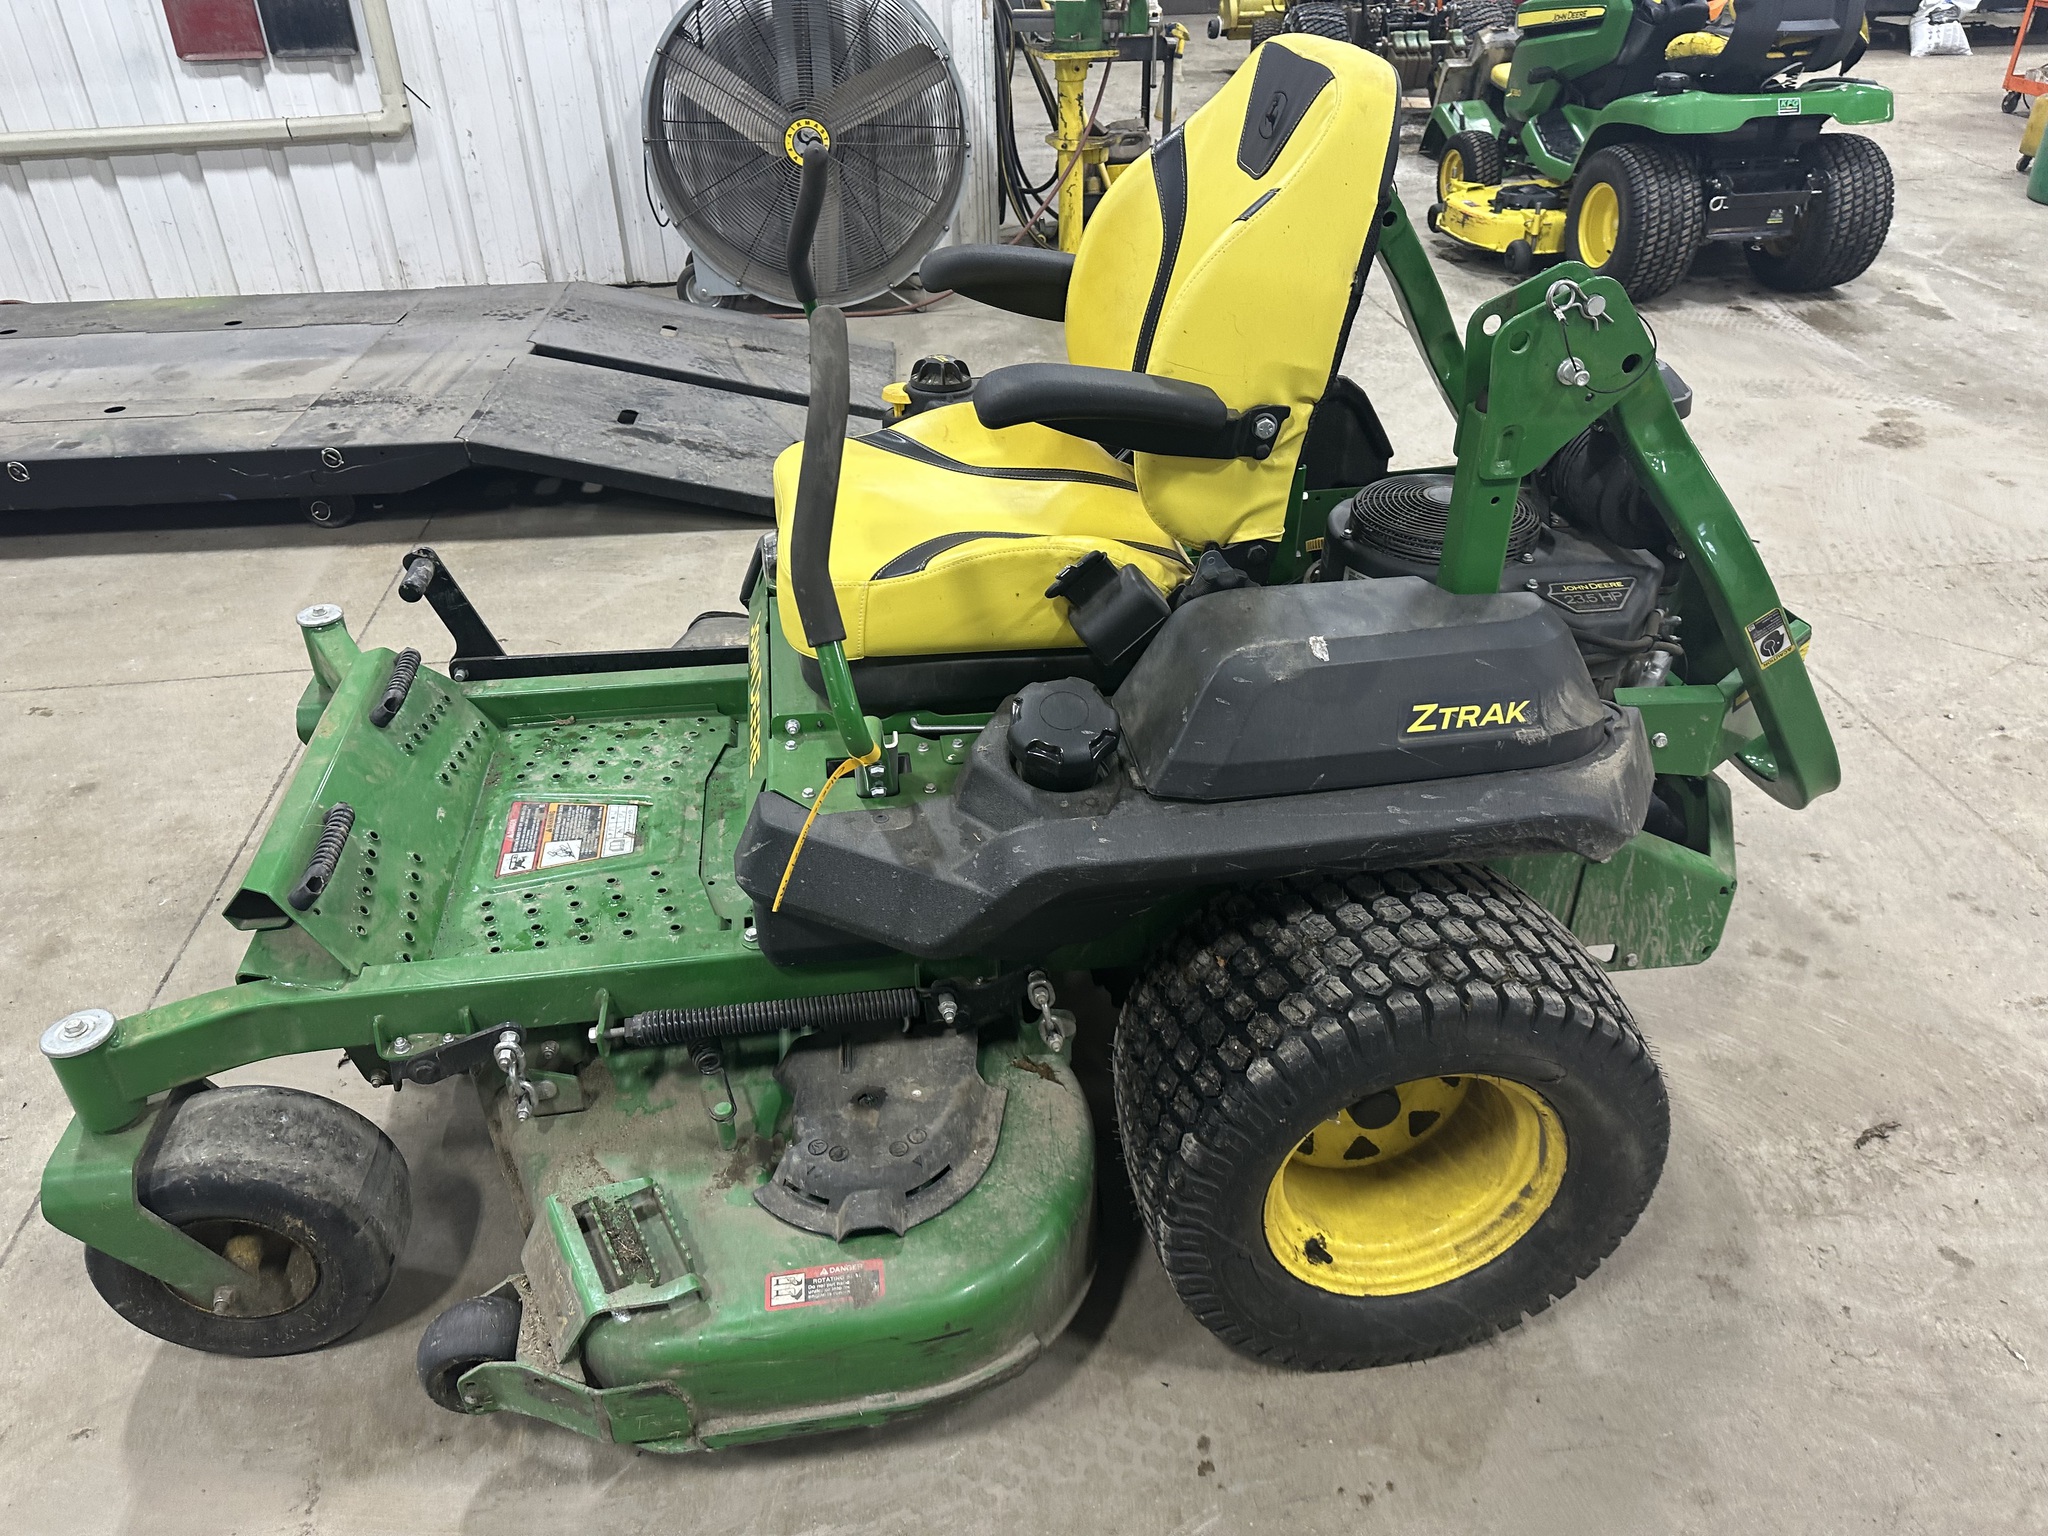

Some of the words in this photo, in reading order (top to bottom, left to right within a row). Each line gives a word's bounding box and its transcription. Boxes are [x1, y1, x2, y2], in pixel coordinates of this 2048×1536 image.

[1553, 13, 1568, 22] JOHN
[1568, 10, 1588, 20] DEERE
[1562, 583, 1589, 591] JOHN
[1589, 581, 1624, 590] DEERE
[1564, 593, 1599, 604] 23.5
[1599, 591, 1623, 602] HP
[1763, 650, 1789, 668] CAUTION
[1406, 700, 1531, 733] ZTRAK
[750, 667, 762, 780] DEERE
[829, 1263, 864, 1274] DANGER
